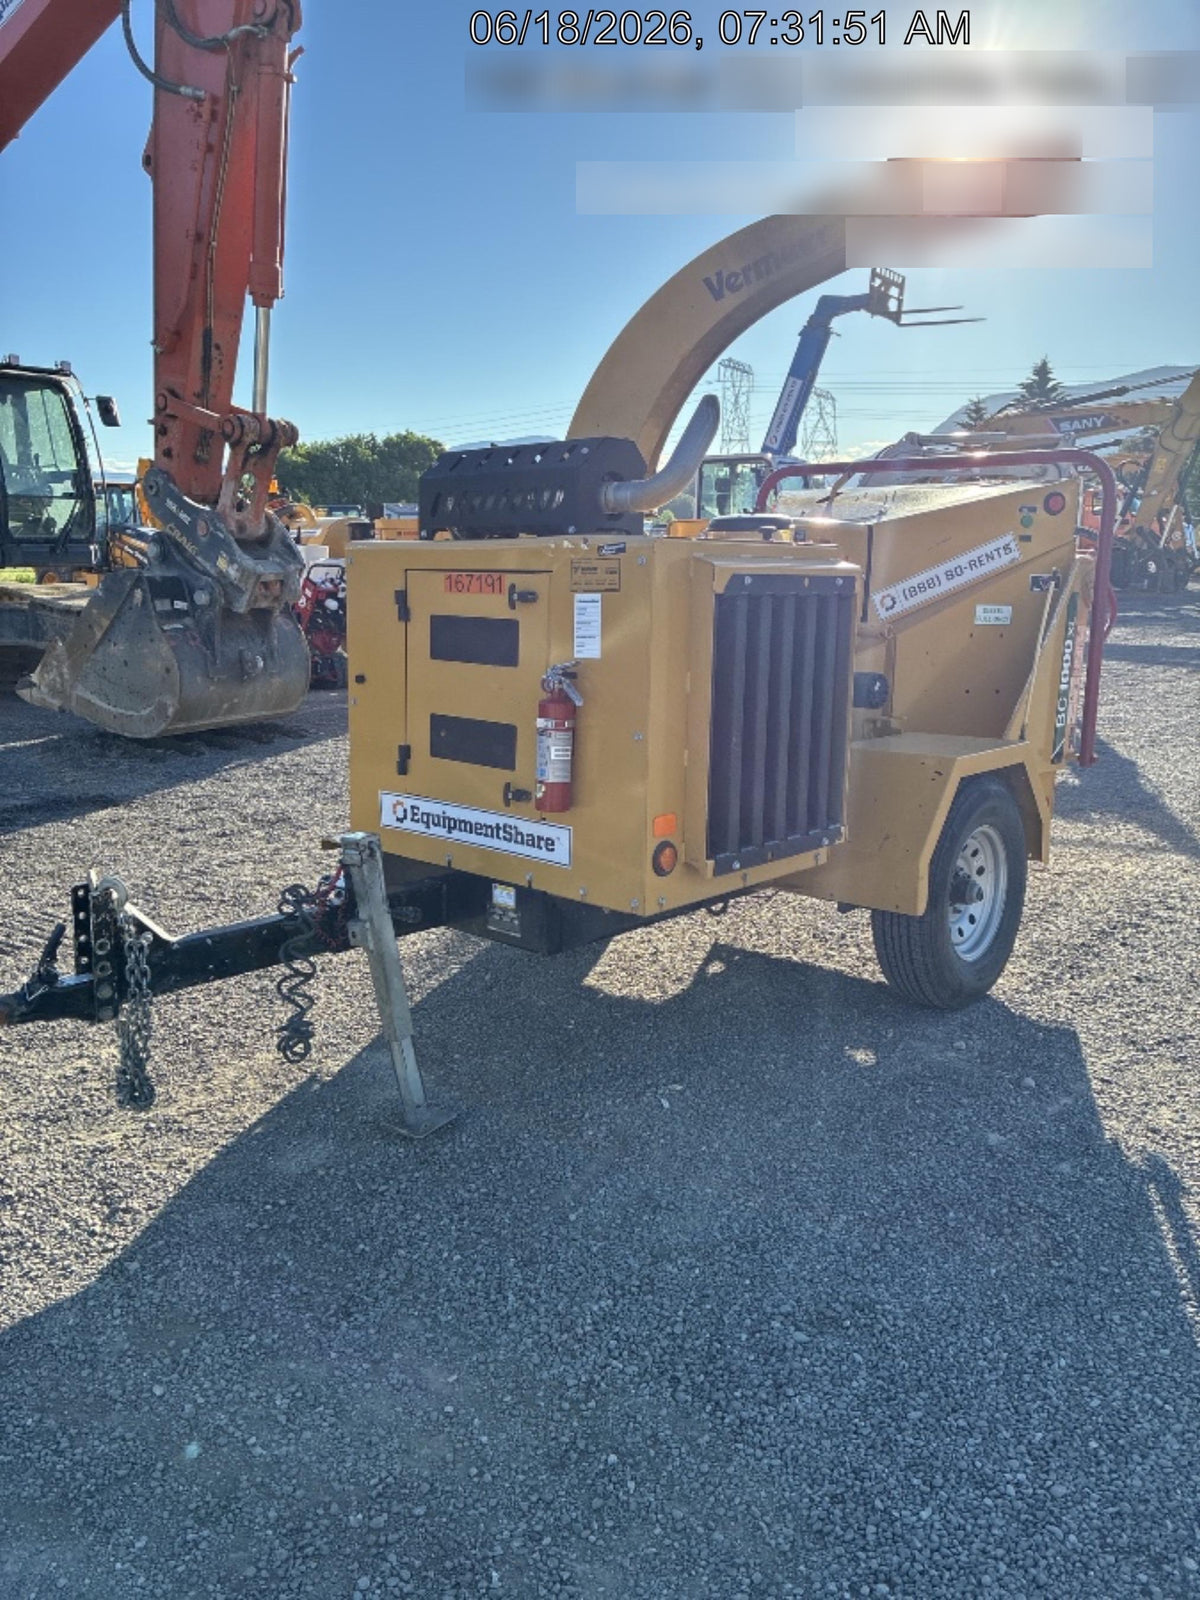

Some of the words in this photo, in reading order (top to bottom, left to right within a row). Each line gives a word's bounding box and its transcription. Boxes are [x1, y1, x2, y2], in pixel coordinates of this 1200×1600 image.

[1059, 415, 1105, 432] SANY
[445, 574, 504, 594] 167191
[902, 575, 942, 600] (888)
[1060, 639, 1073, 691] 1000
[1055, 698, 1068, 728] BC
[409, 804, 556, 852] EquipmentShare
